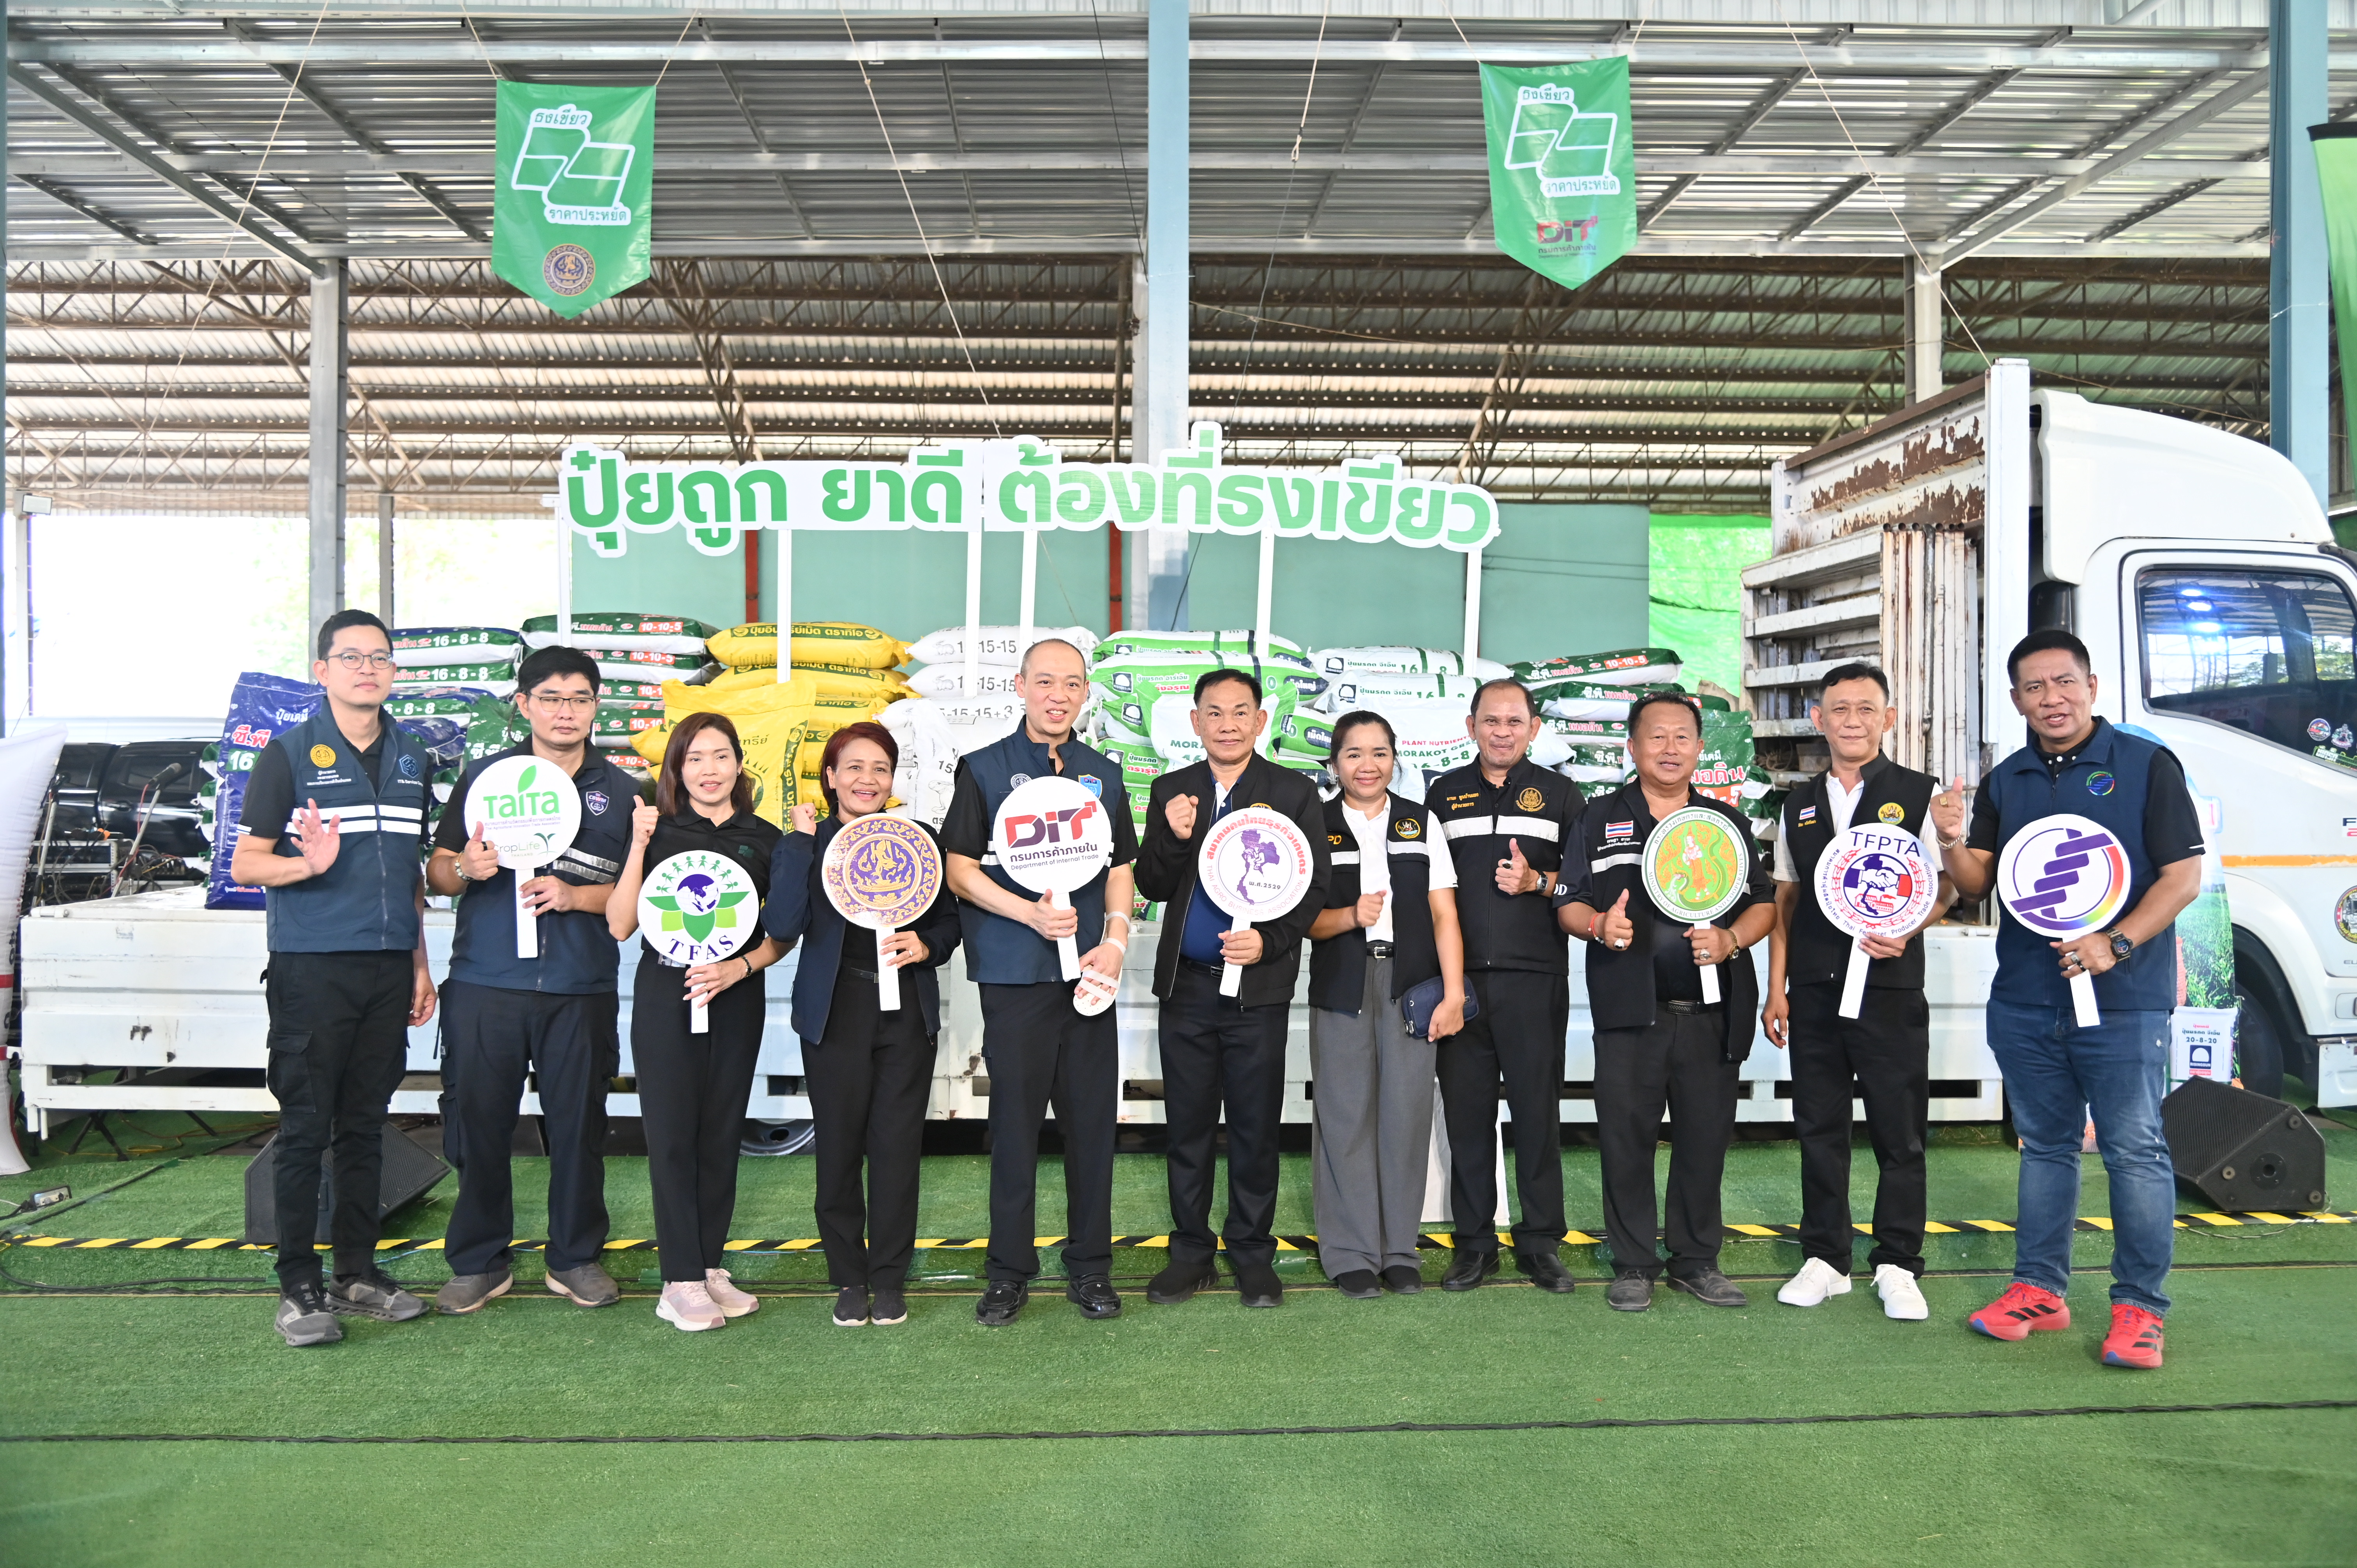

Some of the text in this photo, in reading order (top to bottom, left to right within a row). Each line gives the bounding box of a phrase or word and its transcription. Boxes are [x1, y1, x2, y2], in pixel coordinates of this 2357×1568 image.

[1522, 88, 1570, 100] ธงเขียว
[535, 109, 587, 125] ธงเขียว
[1545, 176, 1616, 193] ราคาประหยัด
[549, 207, 626, 222] ราคาประหยัด
[567, 429, 1491, 550] ปุ๋ยถูก ยาดี ต้องที่ธงเขียว
[641, 622, 682, 631] 10-10-5
[825, 628, 864, 637] ตราทีโอ
[632, 652, 673, 663] 10-10-5
[1606, 655, 1647, 669] 10-10-5
[383, 702, 436, 715] 6-8-8
[275, 708, 309, 726] ปุ๋ยเคมี
[1429, 735, 1470, 746] NUTRIENT
[230, 750, 255, 770] 16
[1129, 753, 1157, 763] ปุ๋ยมรกต
[1127, 766, 1157, 775] ตรารุ่ง
[1010, 842, 1098, 862] กรมการค้าภายใน
[1850, 831, 1921, 858] TFPTA
[1011, 861, 1048, 870] Department
[1057, 856, 1080, 864] Internal
[1249, 881, 1281, 890] พ.ศ.2529
[1648, 871, 1665, 902] MINISTRY
[1670, 907, 1714, 918] AGRICULTURE
[1715, 901, 1727, 911] AND
[1726, 853, 1744, 902] COOPERATIVES
[1923, 862, 1933, 897] Association
[1212, 884, 1227, 902] AGRO
[1228, 901, 1264, 915] BUSINESS
[1268, 879, 1304, 915] ASSOCIATION
[1917, 901, 1930, 917] Trade
[1843, 920, 1855, 931] Thai
[1891, 918, 1917, 935] Producer
[668, 934, 734, 961] TFAS
